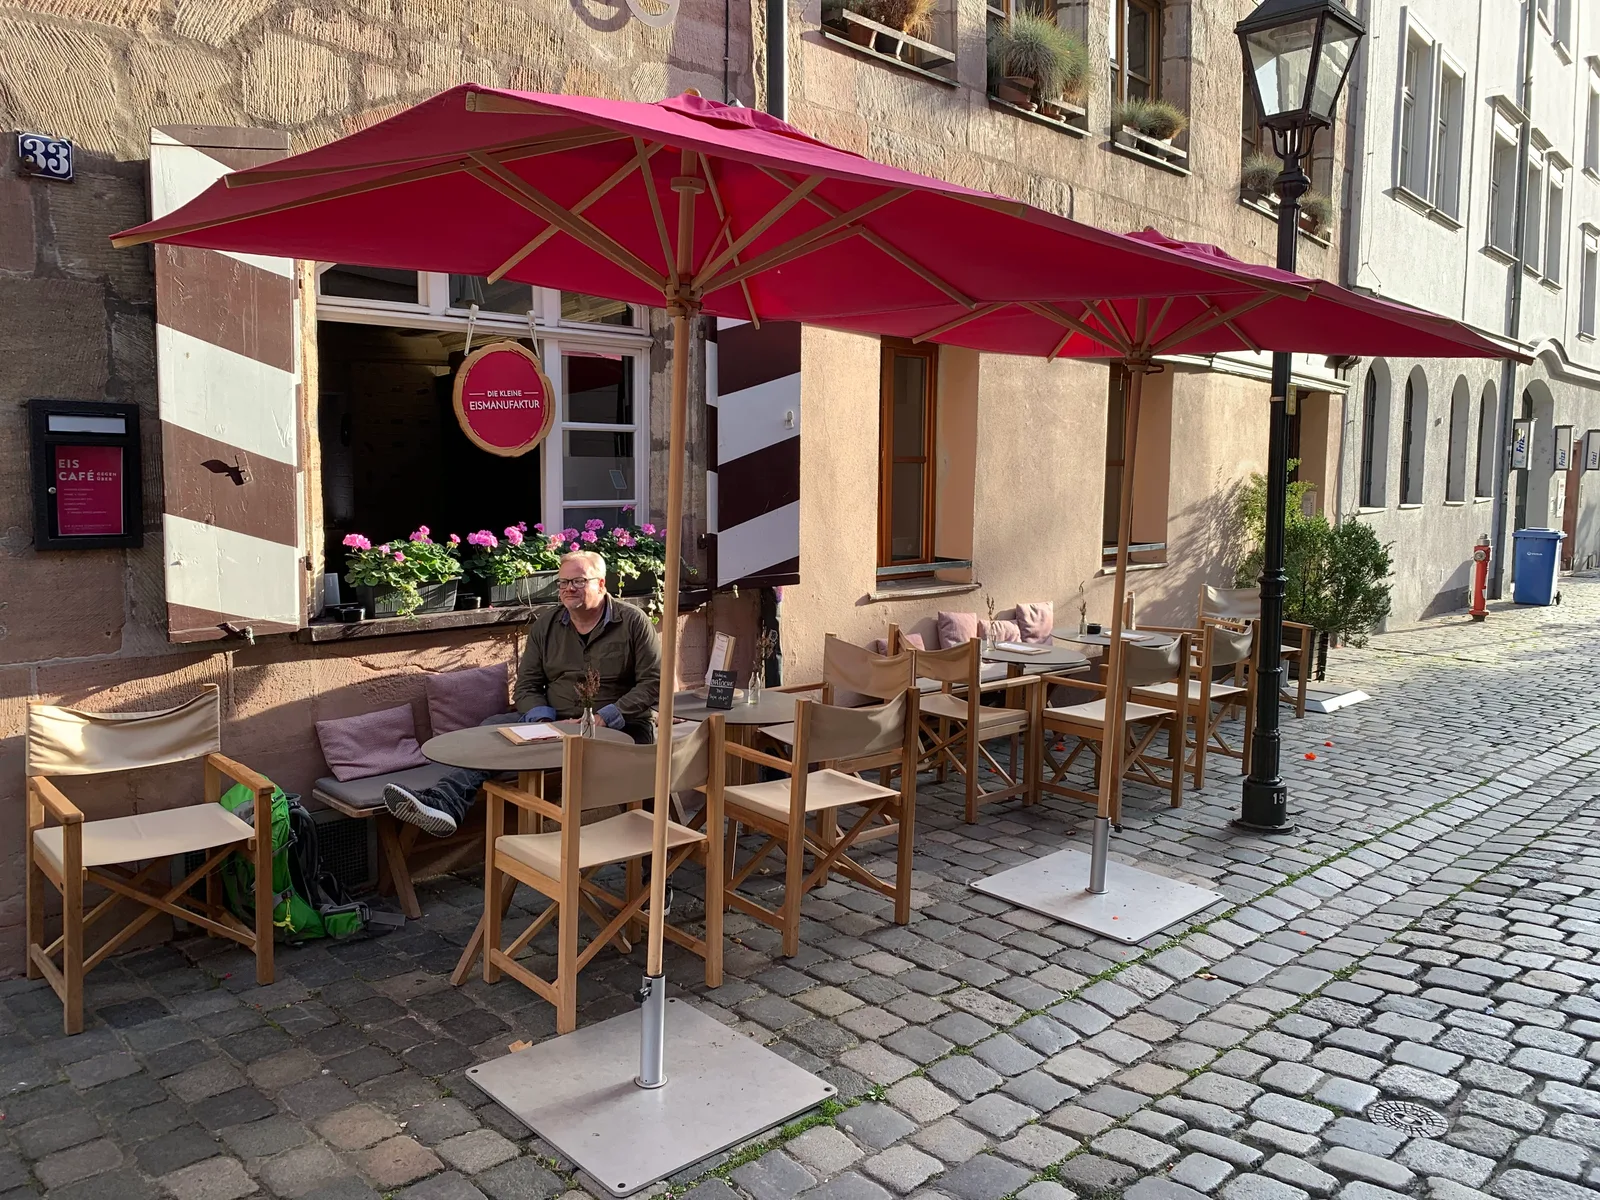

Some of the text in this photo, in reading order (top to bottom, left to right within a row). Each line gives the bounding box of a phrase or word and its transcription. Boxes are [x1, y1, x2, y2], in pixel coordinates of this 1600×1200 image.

[24, 138, 69, 174] 33
[487, 389, 522, 398] DIE KLEINE
[469, 399, 540, 411] EISMANUFAKTUR
[58, 459, 80, 469] EIS
[58, 469, 95, 482] CAFÉ
[1273, 792, 1285, 805] 15
